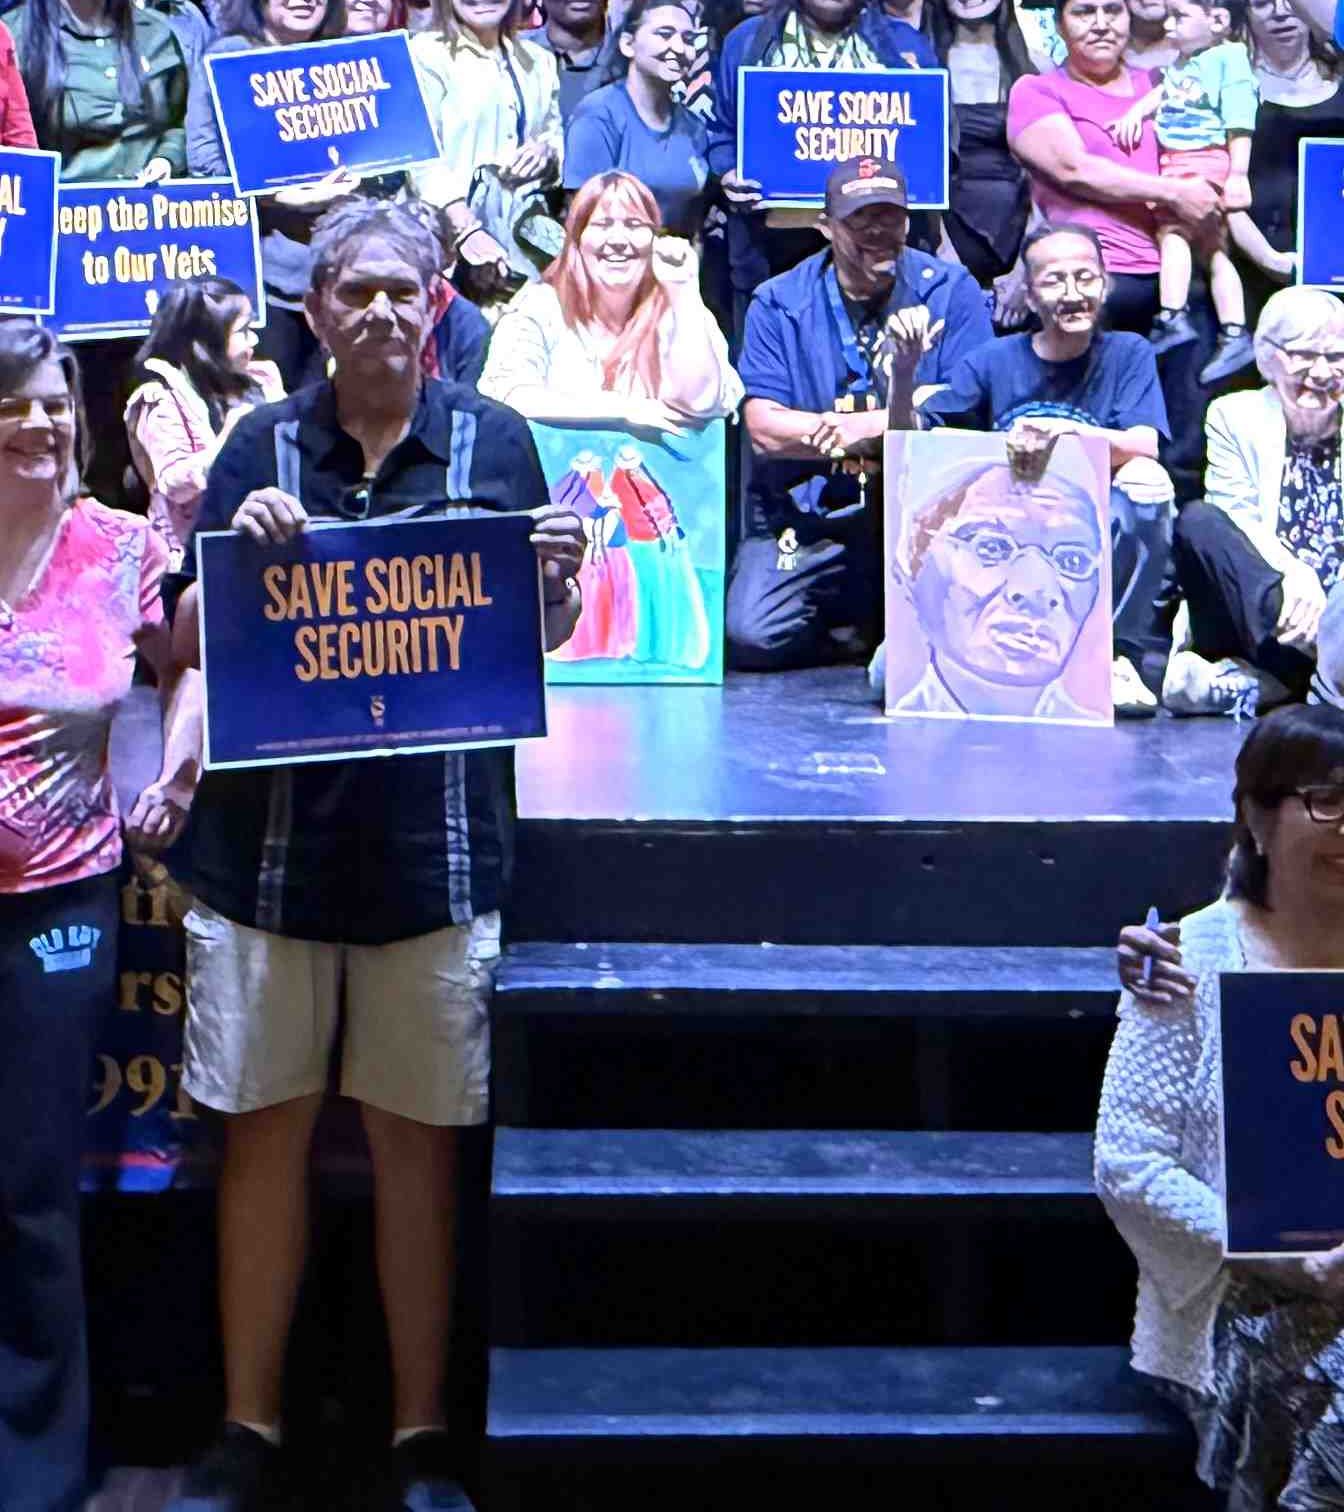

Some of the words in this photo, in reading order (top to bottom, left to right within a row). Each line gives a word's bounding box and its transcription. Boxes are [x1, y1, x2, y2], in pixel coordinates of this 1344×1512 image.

[249, 67, 311, 107] SAVE
[309, 56, 392, 99] SOCIAL
[275, 94, 380, 143] SECURITY
[777, 89, 835, 124] SAVE
[838, 91, 918, 126] SOCIAL
[794, 126, 900, 162] SECURITY
[58, 204, 103, 242] eep
[106, 195, 149, 232] the
[152, 192, 248, 230] Promise
[82, 249, 110, 285] to
[114, 245, 157, 283] Our
[159, 243, 217, 280] Vets
[263, 560, 358, 622] SAVE
[364, 551, 494, 616] SOCIAL
[293, 613, 465, 683] SECURITY
